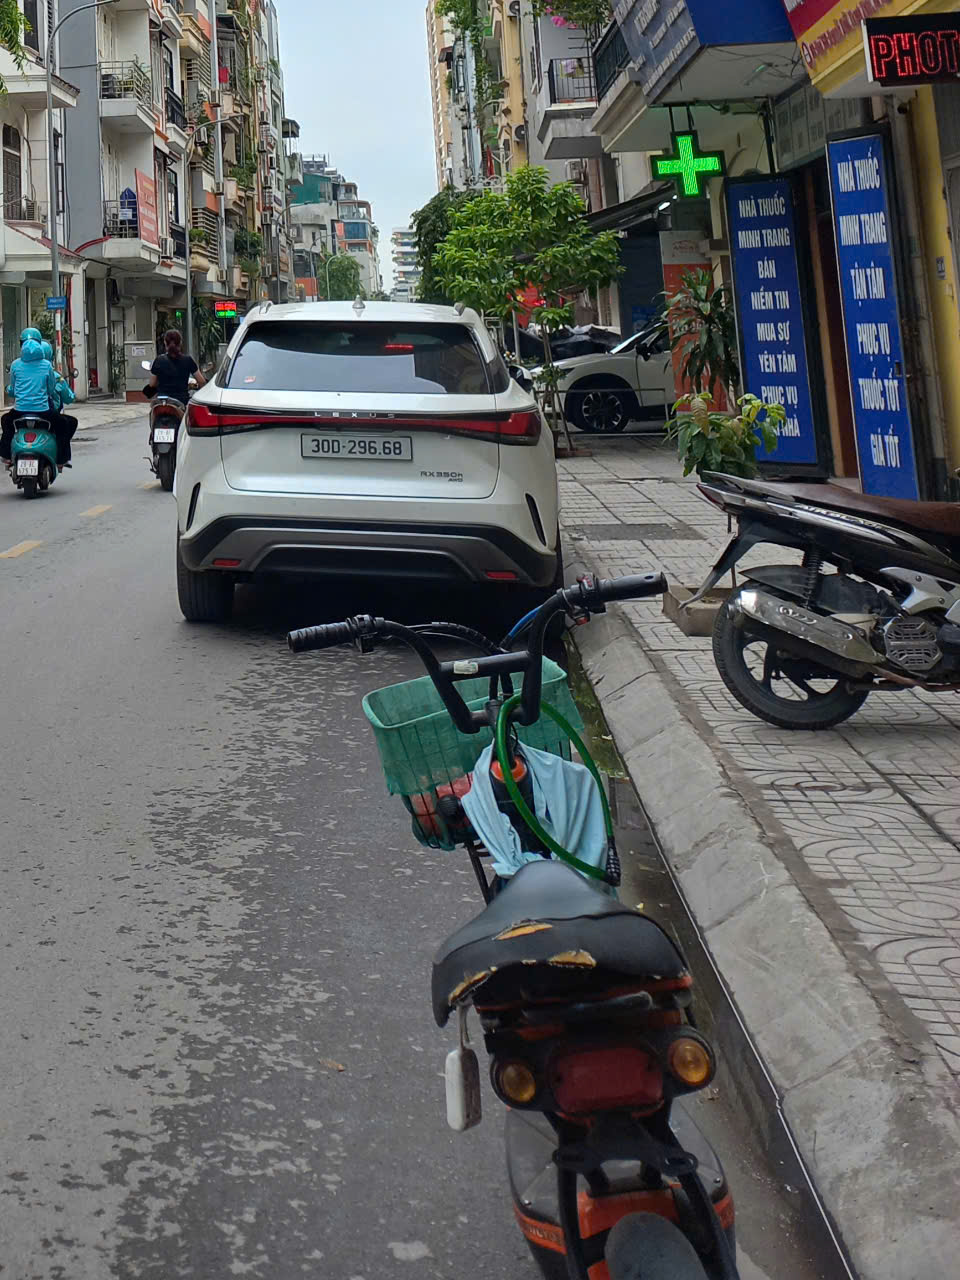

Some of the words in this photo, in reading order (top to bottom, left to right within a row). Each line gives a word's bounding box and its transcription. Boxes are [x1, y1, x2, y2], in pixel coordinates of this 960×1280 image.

[837, 155, 855, 192] NHÀ
[854, 146, 880, 190] THUỐC
[739, 195, 757, 218] NHÀ
[758, 191, 785, 216] THUỐC
[738, 230, 761, 248] MINH
[762, 228, 790, 247] TRANG
[839, 215, 861, 246] MINH
[861, 211, 887, 244] TRANG
[758, 256, 776, 278] BÁN
[850, 261, 867, 307] TẬN
[866, 260, 885, 299] TÂM
[774, 290, 790, 309] TIN
[757, 323, 776, 341] MUA
[777, 320, 790, 344] SỰ
[856, 322, 879, 362] PHỤC
[878, 323, 890, 362] VỤ
[758, 350, 776, 373] YÊN
[777, 350, 797, 373] TÂM
[785, 386, 798, 408] VỤ
[858, 368, 884, 410] THUỐC
[884, 368, 900, 411] TỐT
[314, 411, 395, 419] LEXUS
[311, 438, 402, 455] 30D-296.68
[870, 427, 885, 467] GIÁ
[884, 424, 900, 468] TỐT
